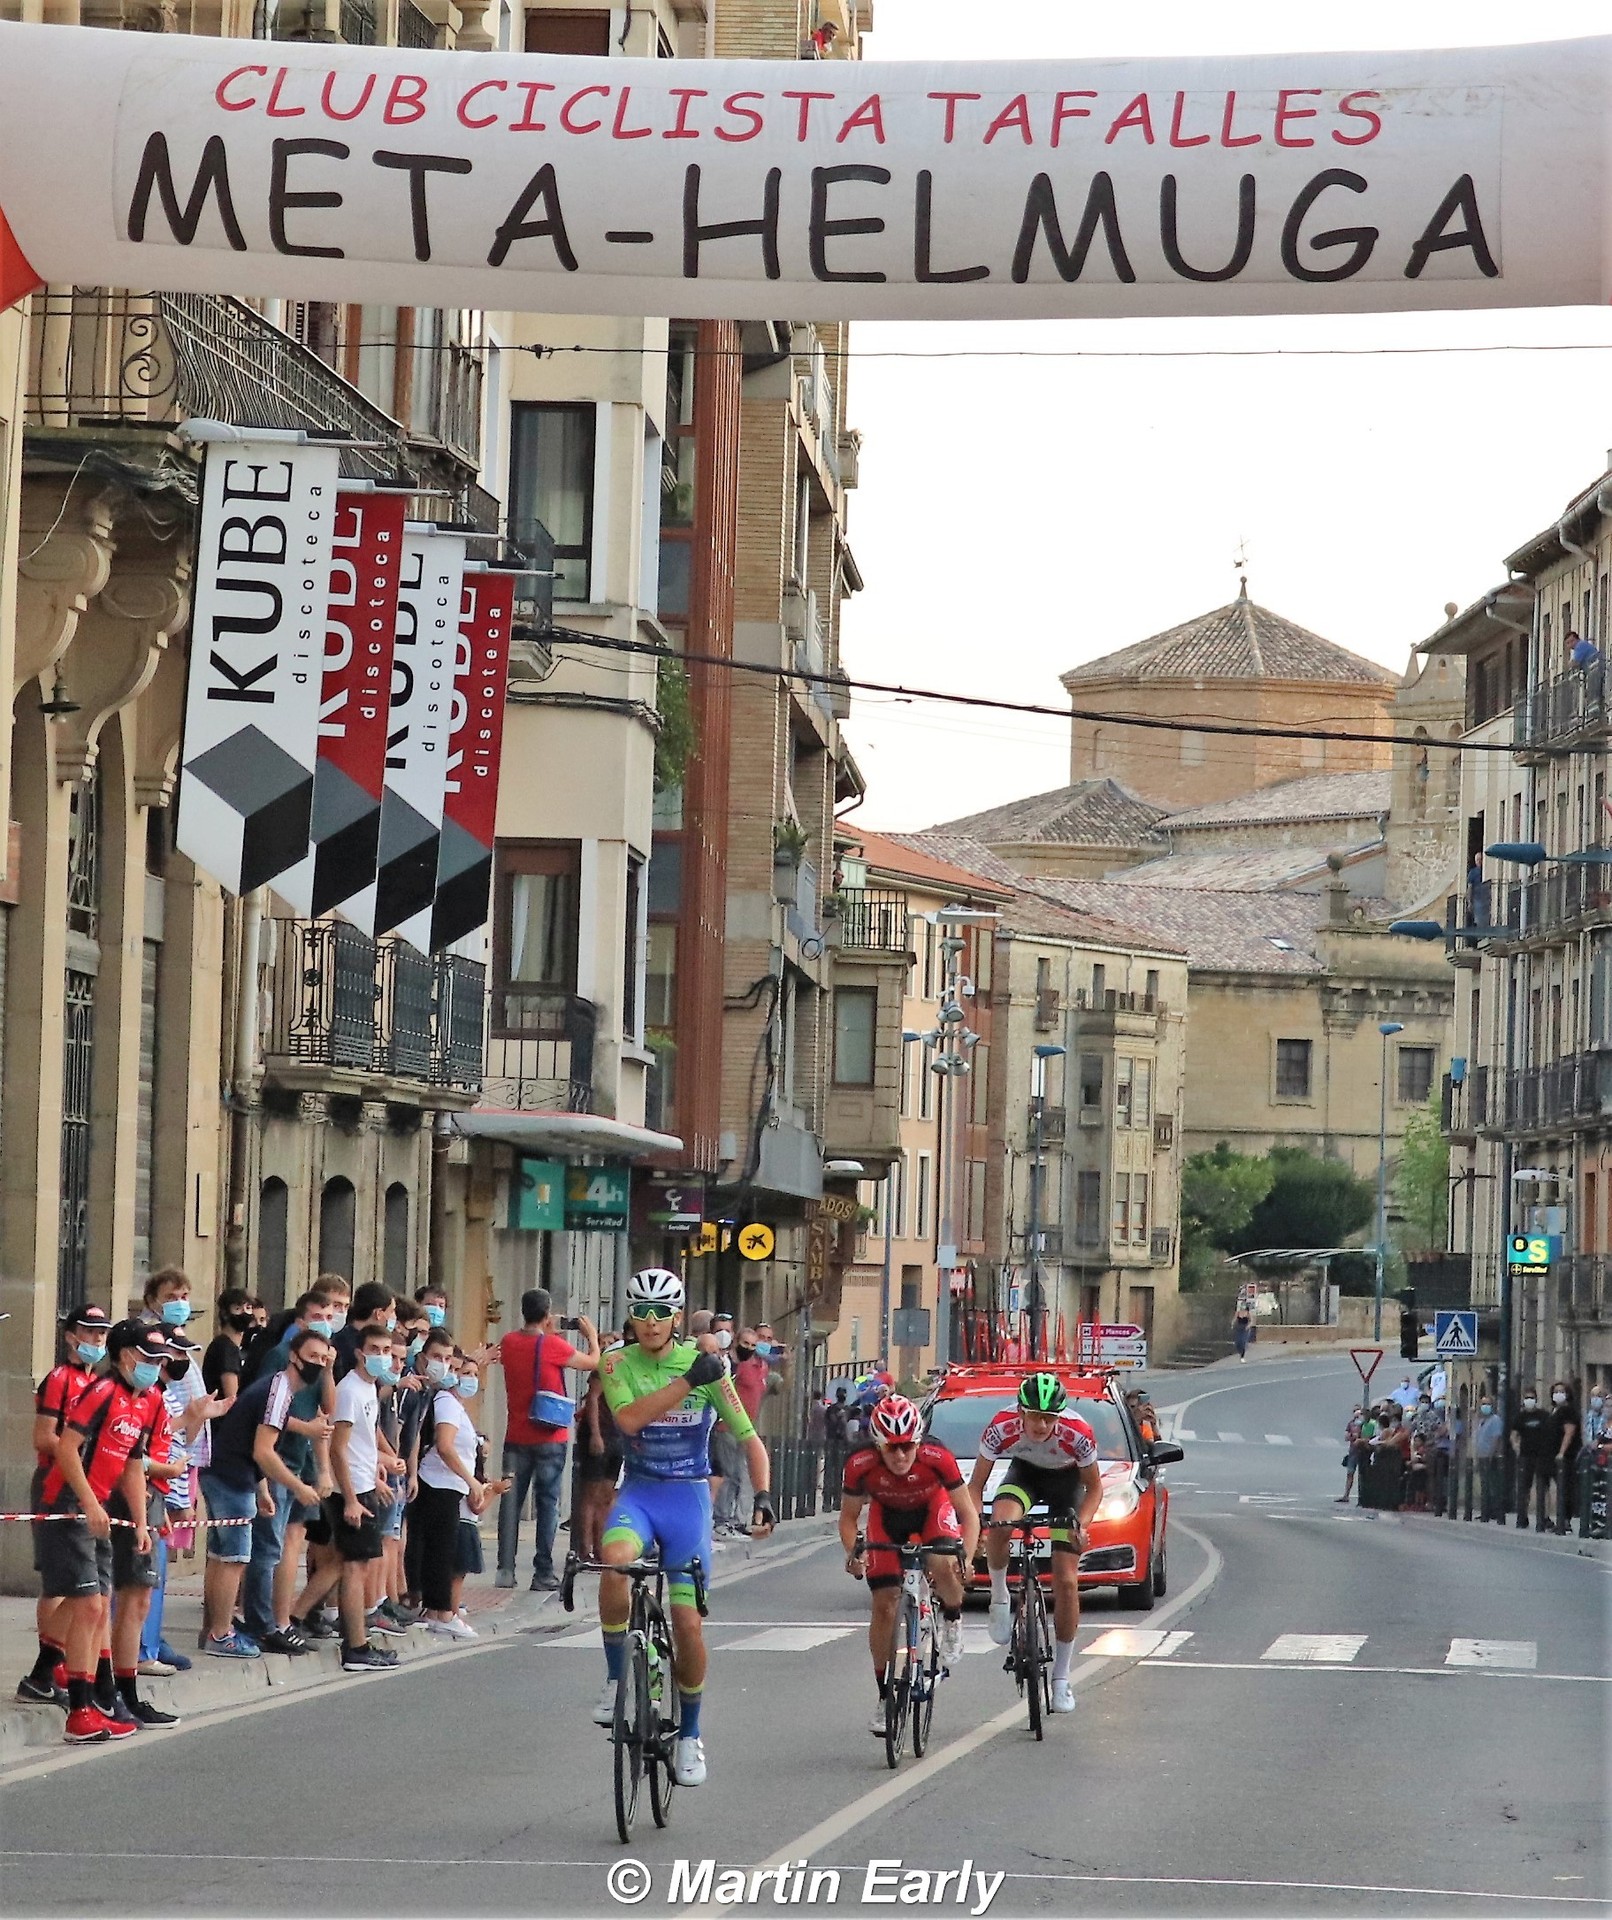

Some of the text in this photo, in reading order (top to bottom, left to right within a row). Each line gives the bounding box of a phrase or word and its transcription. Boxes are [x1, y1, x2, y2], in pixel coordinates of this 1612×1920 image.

[216, 65, 1382, 148] CLUB CICLISTA TAFALLES
[127, 131, 1499, 284] META-HELMUGA
[207, 460, 294, 703] KUBE
[292, 485, 323, 684] discoteca
[360, 530, 391, 720] discoteca
[421, 575, 450, 752] discoteca
[473, 607, 502, 777] discoteca
[568, 1171, 624, 1209] 24h
